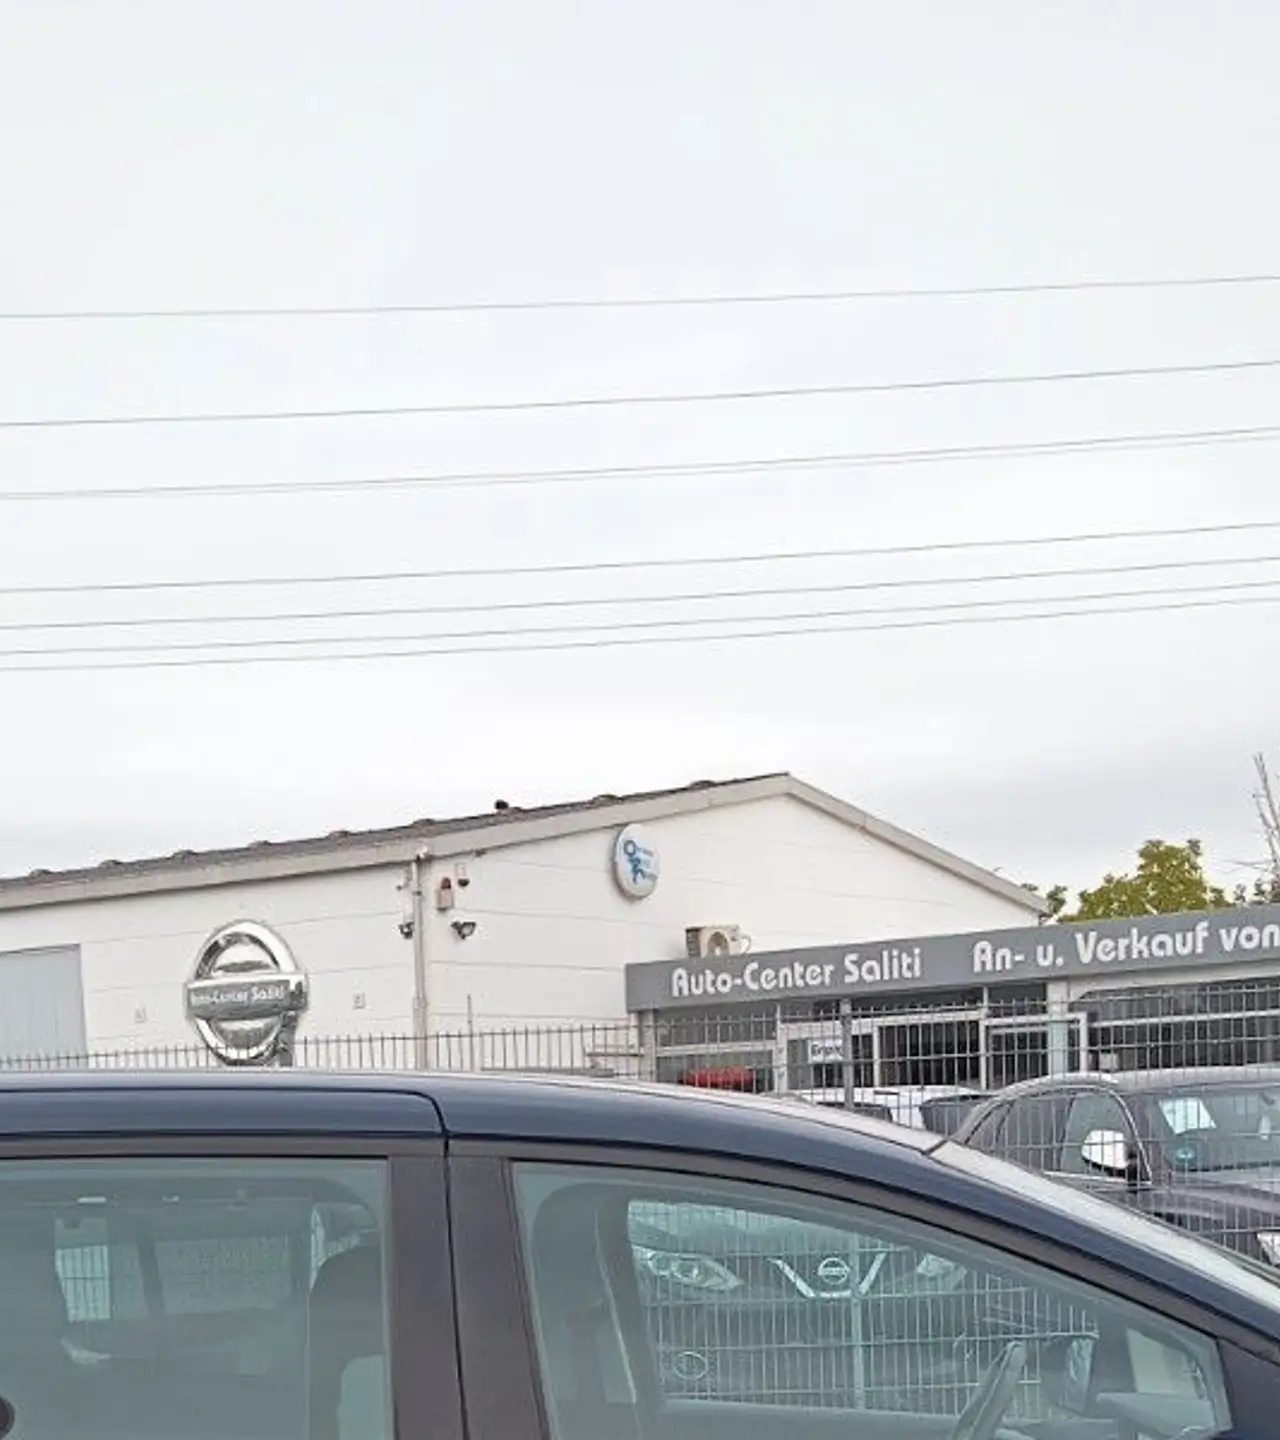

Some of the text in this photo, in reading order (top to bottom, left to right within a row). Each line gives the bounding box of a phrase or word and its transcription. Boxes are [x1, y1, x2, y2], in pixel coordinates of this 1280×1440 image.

[972, 940, 1025, 973] An-
[1036, 944, 1064, 967] u.
[1074, 921, 1209, 965] Verkauf
[671, 948, 921, 998] Auto-Center Saliti
